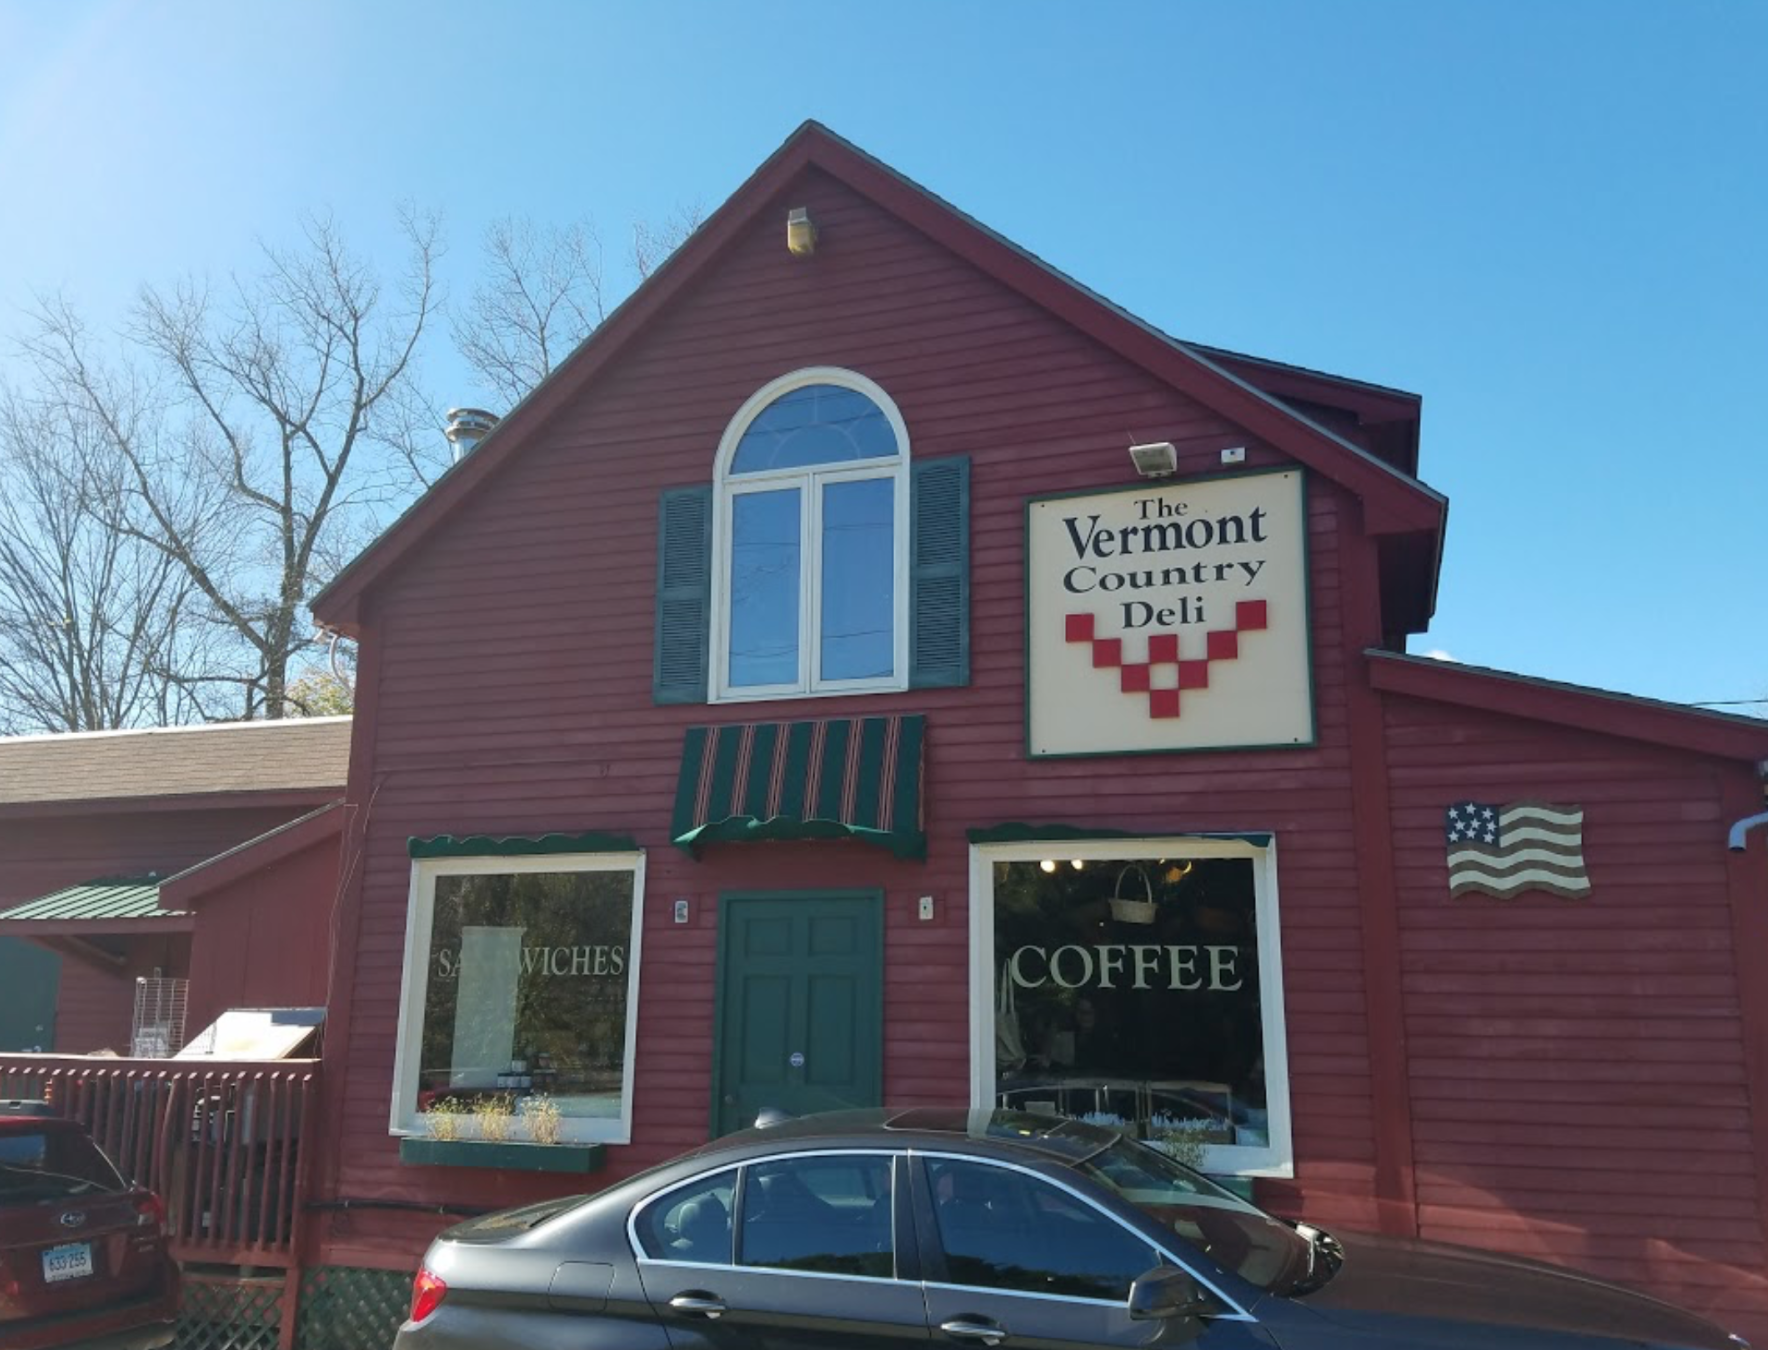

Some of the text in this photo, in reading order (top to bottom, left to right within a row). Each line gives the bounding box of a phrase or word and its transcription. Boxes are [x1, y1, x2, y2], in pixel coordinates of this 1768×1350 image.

[1133, 497, 1188, 520] The
[1062, 506, 1268, 560] Vermont
[1063, 560, 1266, 594] Country
[1120, 596, 1206, 629] Deli
[1011, 944, 1243, 991] COFFEE
